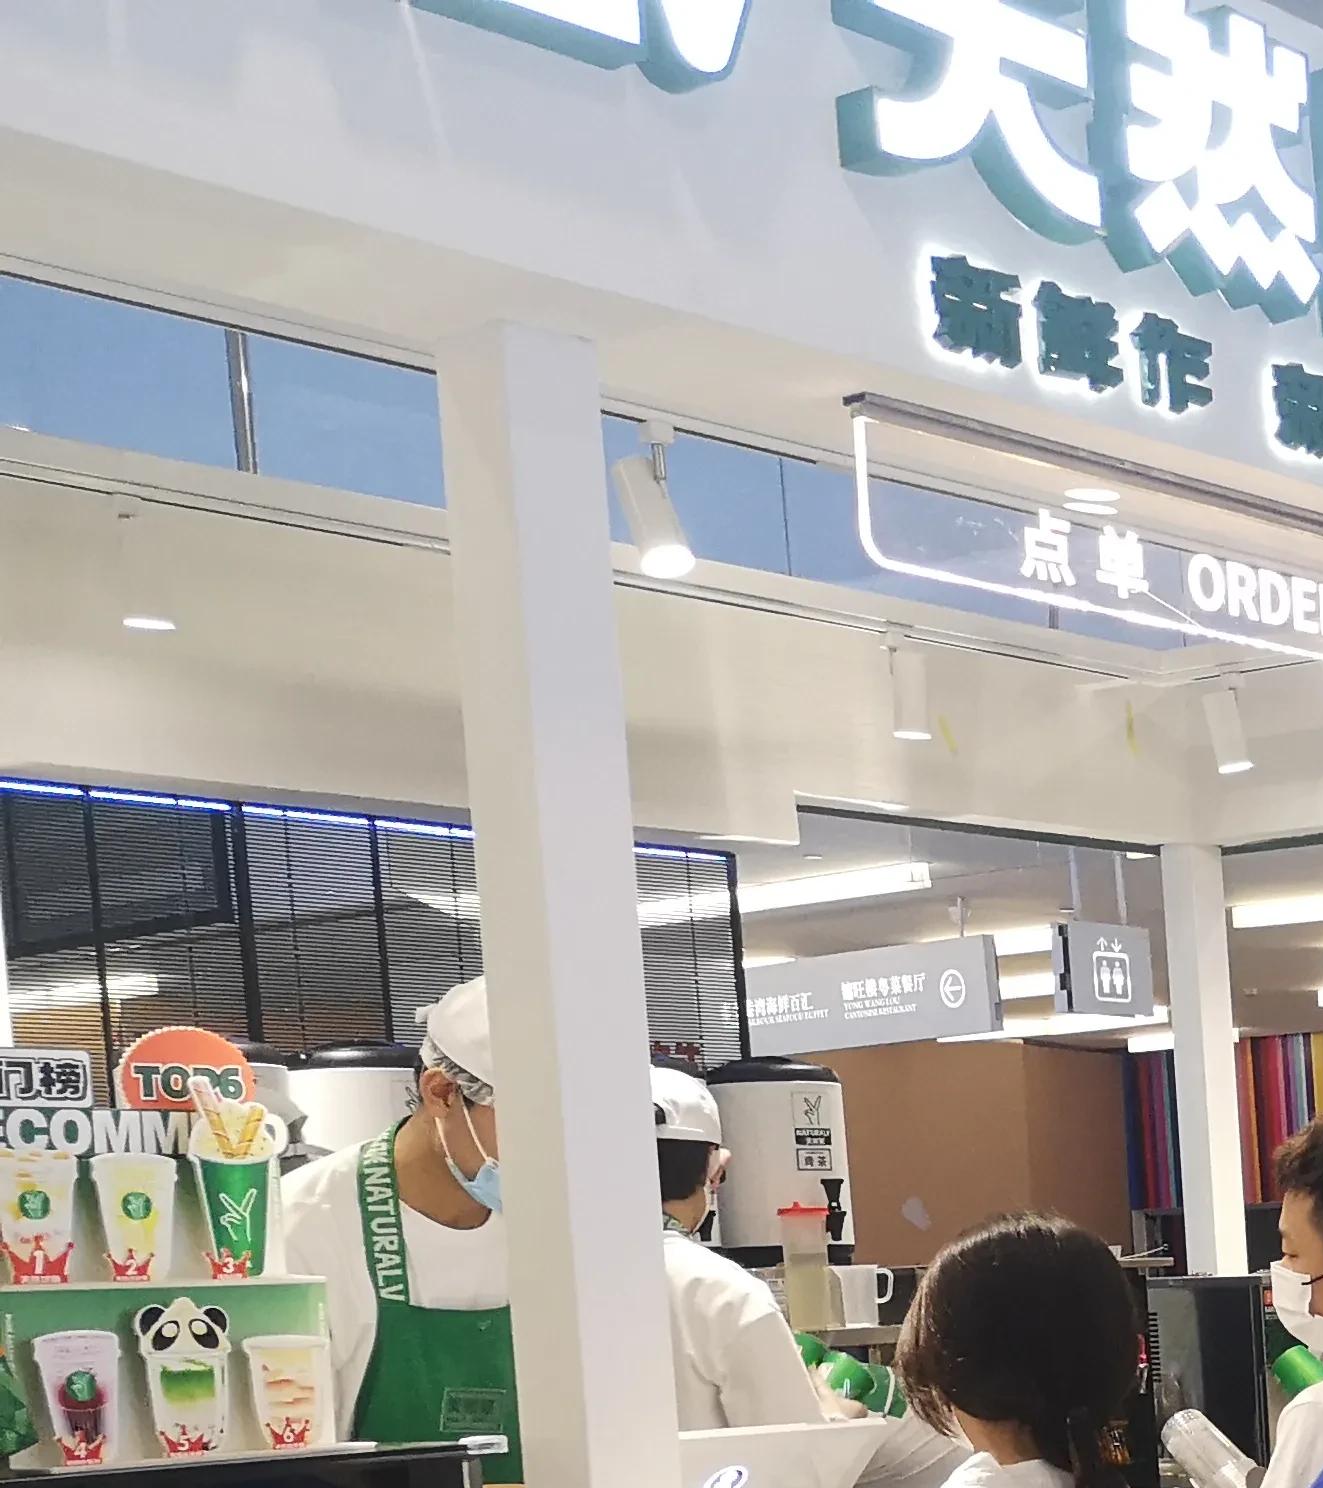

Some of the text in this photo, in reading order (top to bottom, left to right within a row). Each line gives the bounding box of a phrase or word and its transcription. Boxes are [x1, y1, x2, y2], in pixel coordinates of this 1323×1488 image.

[1018, 508, 1150, 600] 点单
[32, 1250, 44, 1275] 1
[124, 1258, 138, 1276] 2
[222, 1257, 236, 1274] 3
[177, 1435, 190, 1451] 5
[282, 1427, 295, 1443] 6
[73, 1441, 88, 1460] 4
